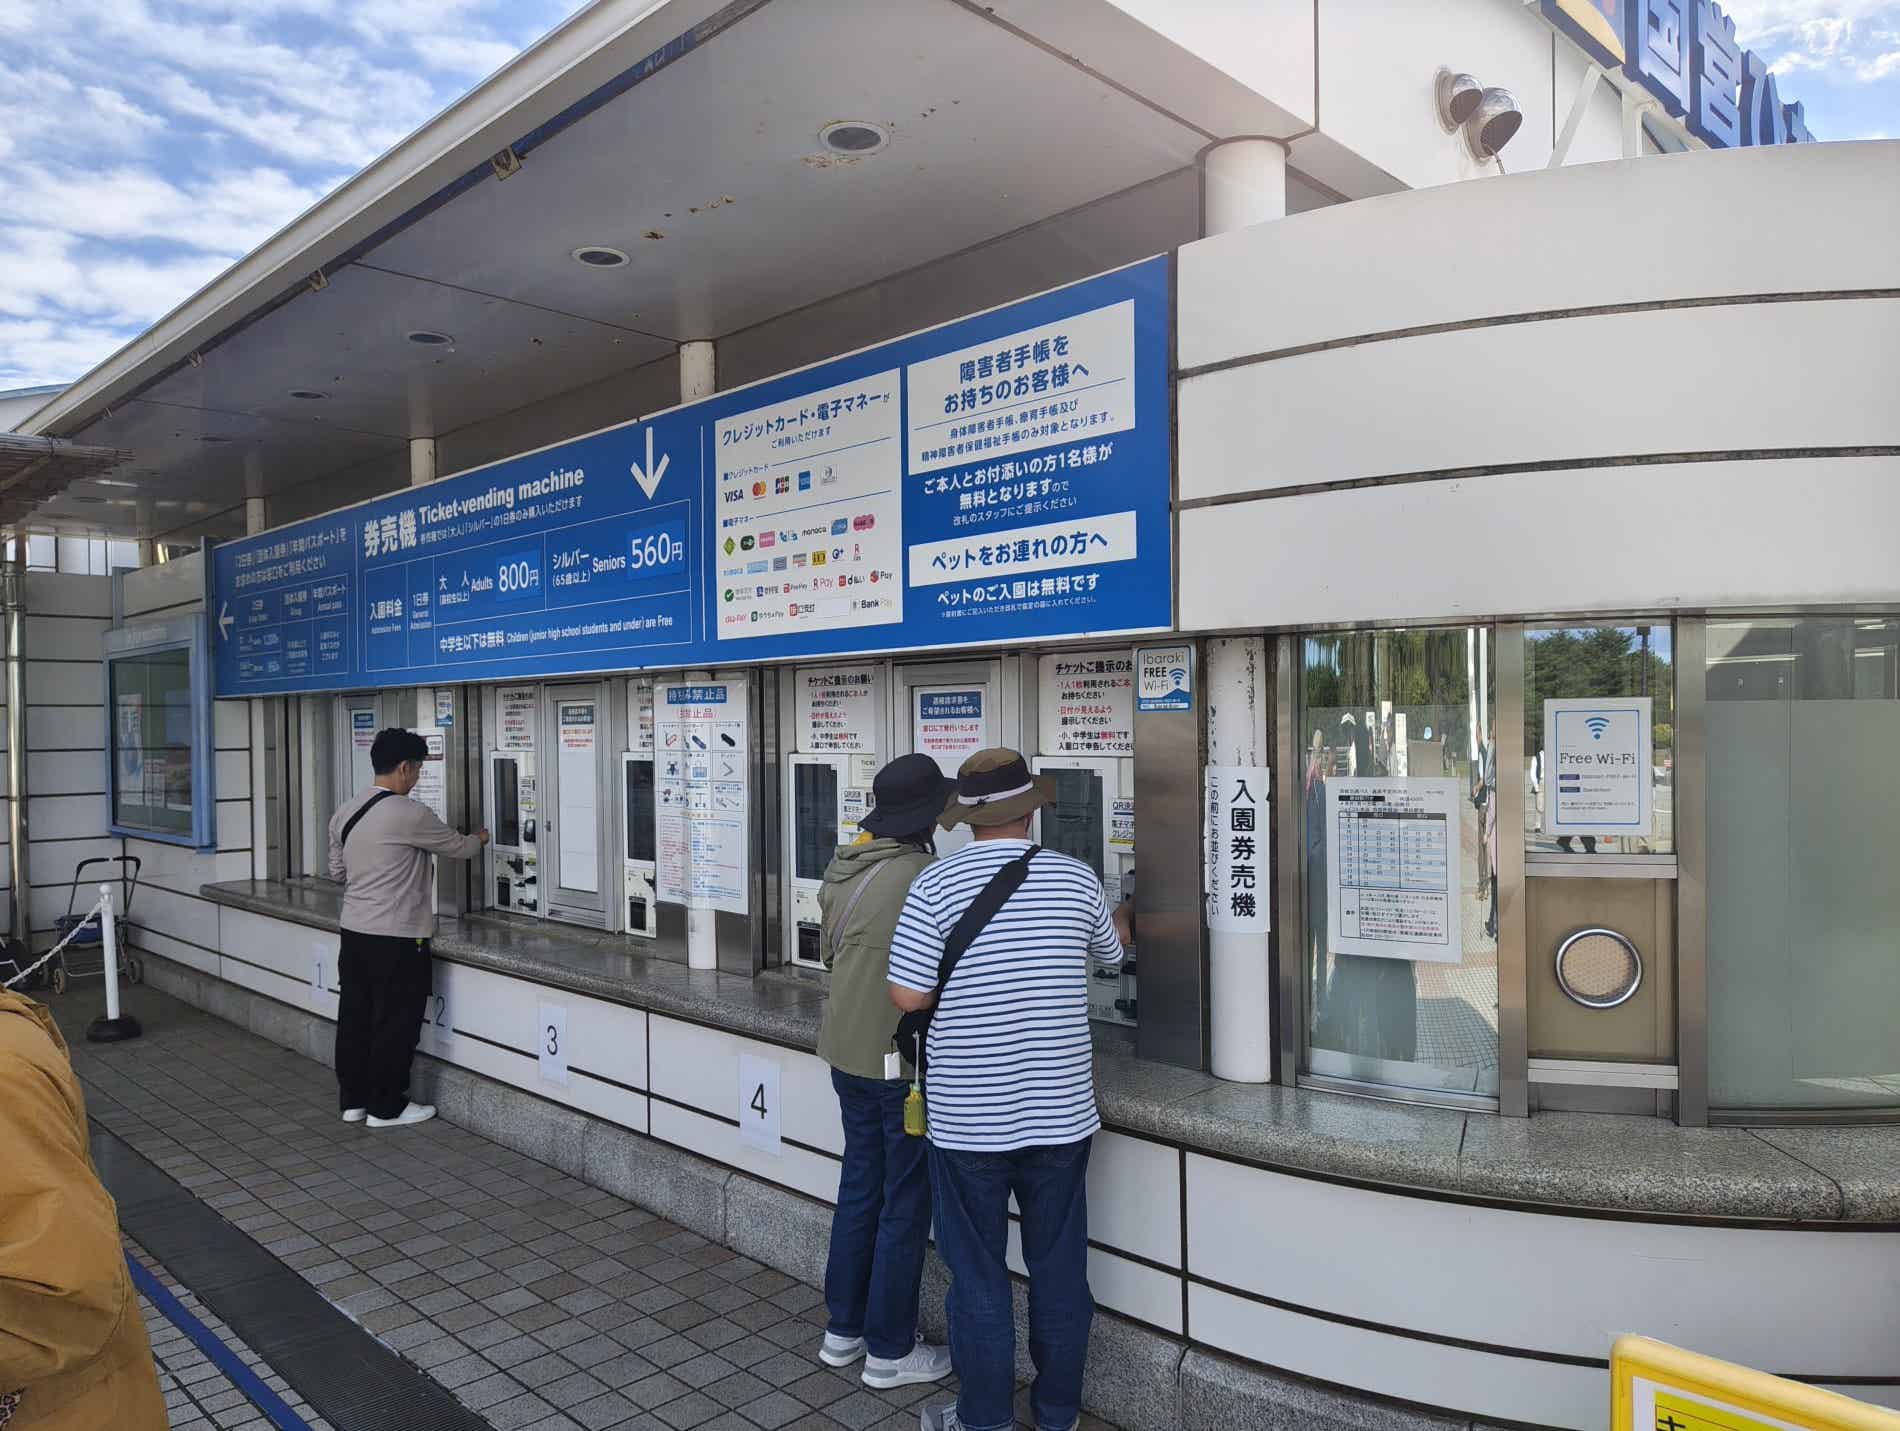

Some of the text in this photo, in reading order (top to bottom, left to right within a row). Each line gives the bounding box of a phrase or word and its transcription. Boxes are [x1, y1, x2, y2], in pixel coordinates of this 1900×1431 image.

[959, 335, 1069, 384] 障害者手帳を
[944, 363, 1089, 414] お持ちのお客様へ
[722, 392, 891, 447] クレジットカード・電子マネーが
[924, 442, 1113, 495] ご本人とお付添いの方1名様が
[419, 468, 584, 526] Ticket-vending machine
[724, 488, 744, 503] VISA
[959, 478, 1069, 511] 無料となりますので
[953, 496, 1077, 526] 改札のスタッフにご提示ください
[363, 509, 417, 558] 券売機
[552, 548, 590, 569] シルバー
[592, 555, 626, 573] Seniors
[631, 532, 683, 569] 560円
[932, 531, 1109, 570] ペットをお連れの方へ
[471, 576, 493, 592] Adults
[499, 561, 539, 592] 800円
[937, 573, 1100, 606] ペットのご入園は無料です
[369, 598, 403, 621] 入園料金
[439, 629, 504, 652] 中学生以下は無料
[507, 632, 528, 643] Children
[548, 628, 560, 641] high
[561, 625, 581, 638] school
[582, 622, 608, 635] students
[609, 620, 622, 632] and
[623, 616, 645, 630] under)
[646, 617, 657, 628] are
[657, 614, 673, 627] Free
[1143, 652, 1185, 665] Ibaraki
[1144, 666, 1167, 679] FREE
[1061, 691, 1104, 701] お持ちください
[1144, 680, 1169, 692] Wi-Fi
[1061, 716, 1111, 726] 提示してください
[1559, 752, 1635, 765] Free Wi-Fi
[1230, 779, 1256, 918] 入園券売機
[316, 962, 324, 989] 1
[436, 996, 446, 1027] 2
[546, 1024, 558, 1056] 3
[750, 1082, 767, 1120] 4
